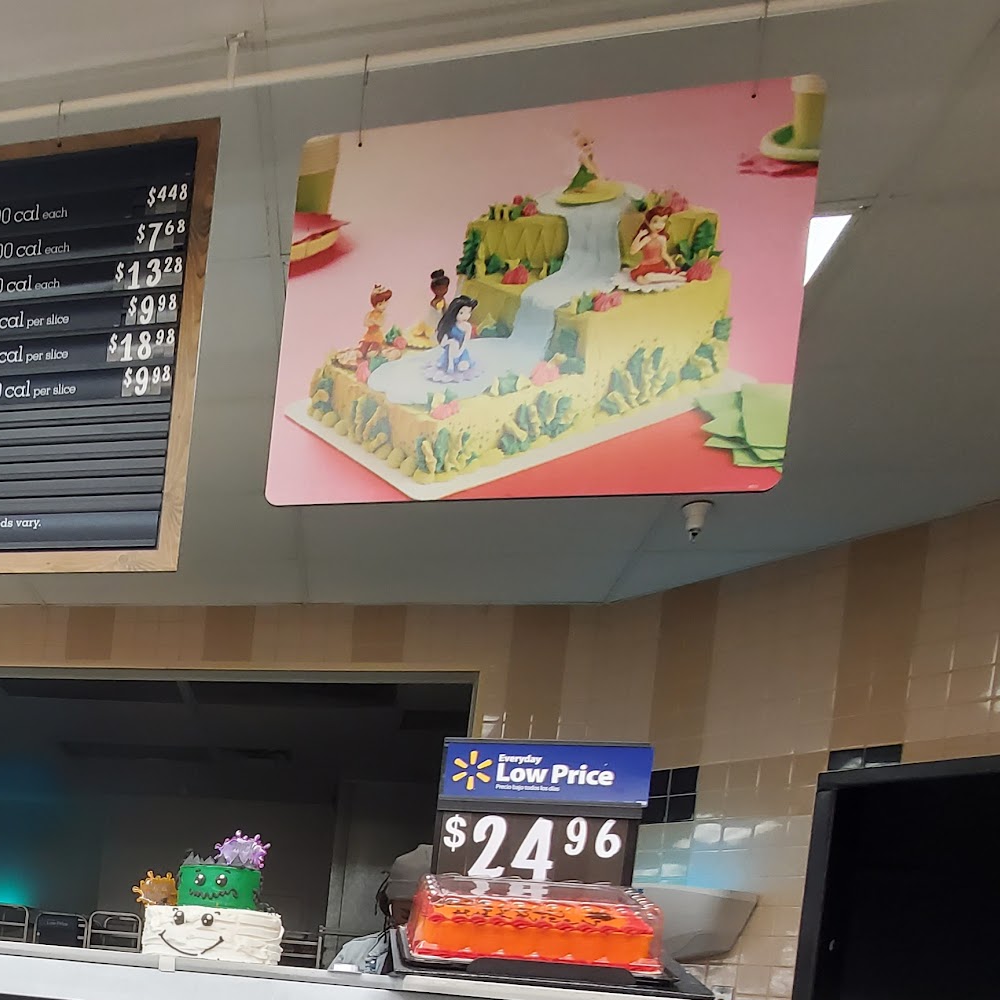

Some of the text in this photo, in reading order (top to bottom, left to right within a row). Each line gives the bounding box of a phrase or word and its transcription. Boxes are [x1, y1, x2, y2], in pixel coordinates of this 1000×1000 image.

[14, 204, 40, 222] cal
[42, 208, 68, 220] each
[16, 239, 42, 258] cal
[44, 242, 70, 255] each
[6, 275, 32, 292] cal
[34, 278, 60, 290] each
[26, 317, 44, 330] per
[46, 314, 69, 326] slice
[26, 352, 42, 364] per
[46, 348, 68, 360] slice
[4, 380, 30, 398] cal
[33, 386, 51, 399] per
[53, 383, 76, 394] slice
[16, 519, 42, 530] vary.
[498, 754, 543, 764] Everyday
[496, 763, 615, 786] Low Price
